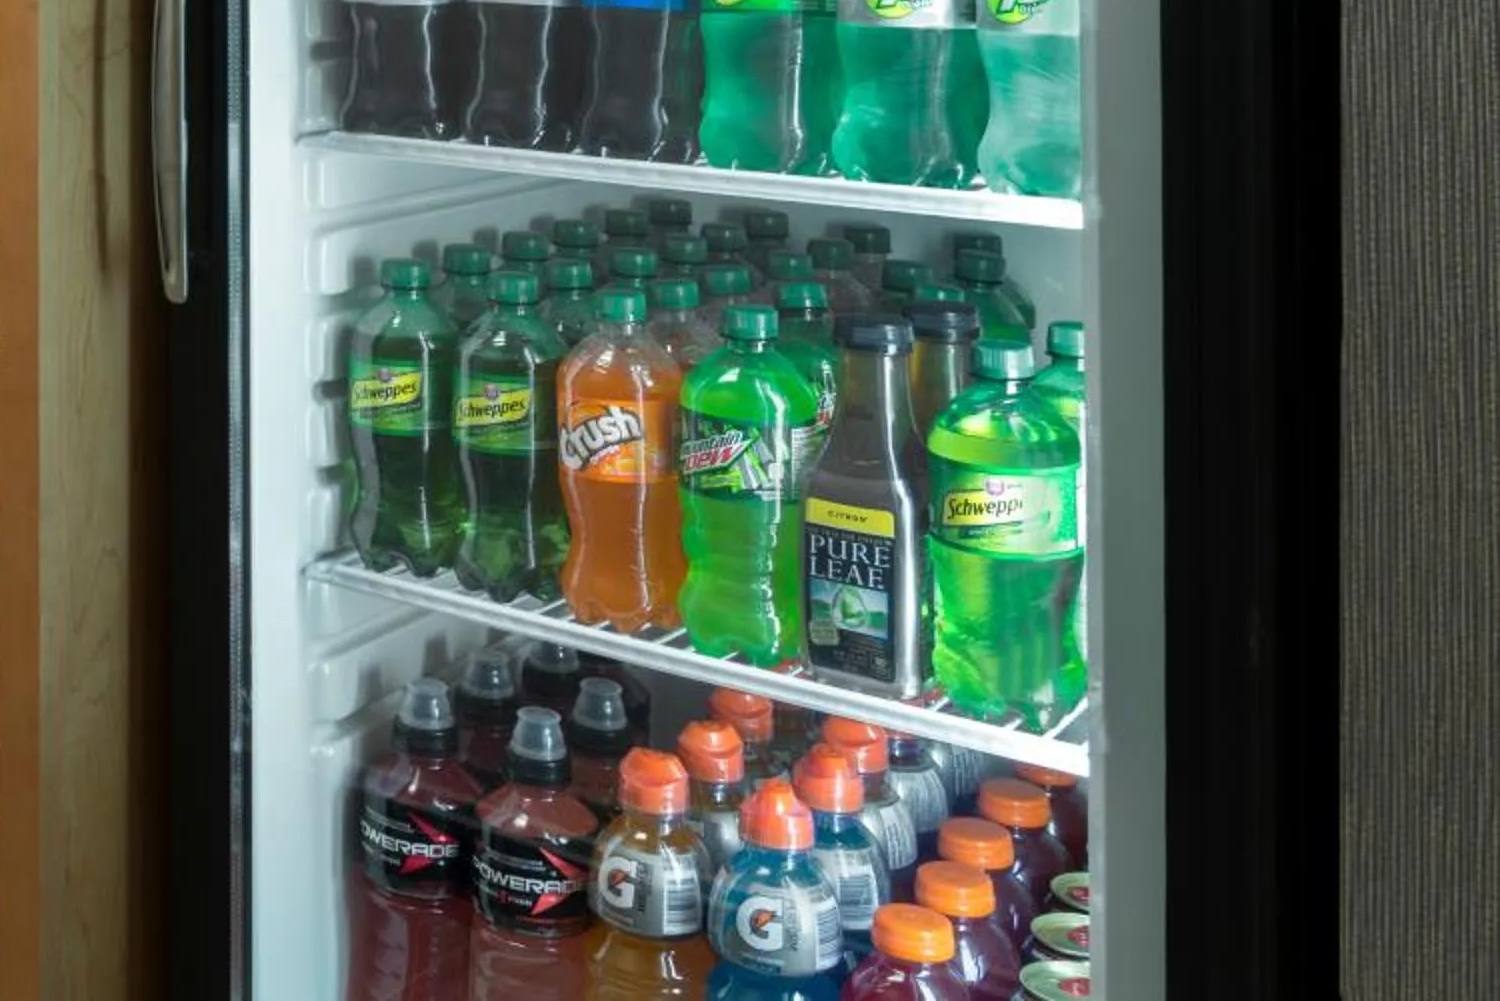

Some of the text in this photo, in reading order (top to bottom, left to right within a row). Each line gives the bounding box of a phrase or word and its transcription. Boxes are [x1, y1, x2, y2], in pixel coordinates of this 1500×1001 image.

[354, 379, 418, 402] Schweppes
[458, 399, 526, 419] Schweppes
[561, 406, 643, 470] Crush
[809, 533, 891, 568] PURE
[809, 556, 885, 590] LEAF
[600, 856, 636, 909] G
[736, 896, 784, 952] G
